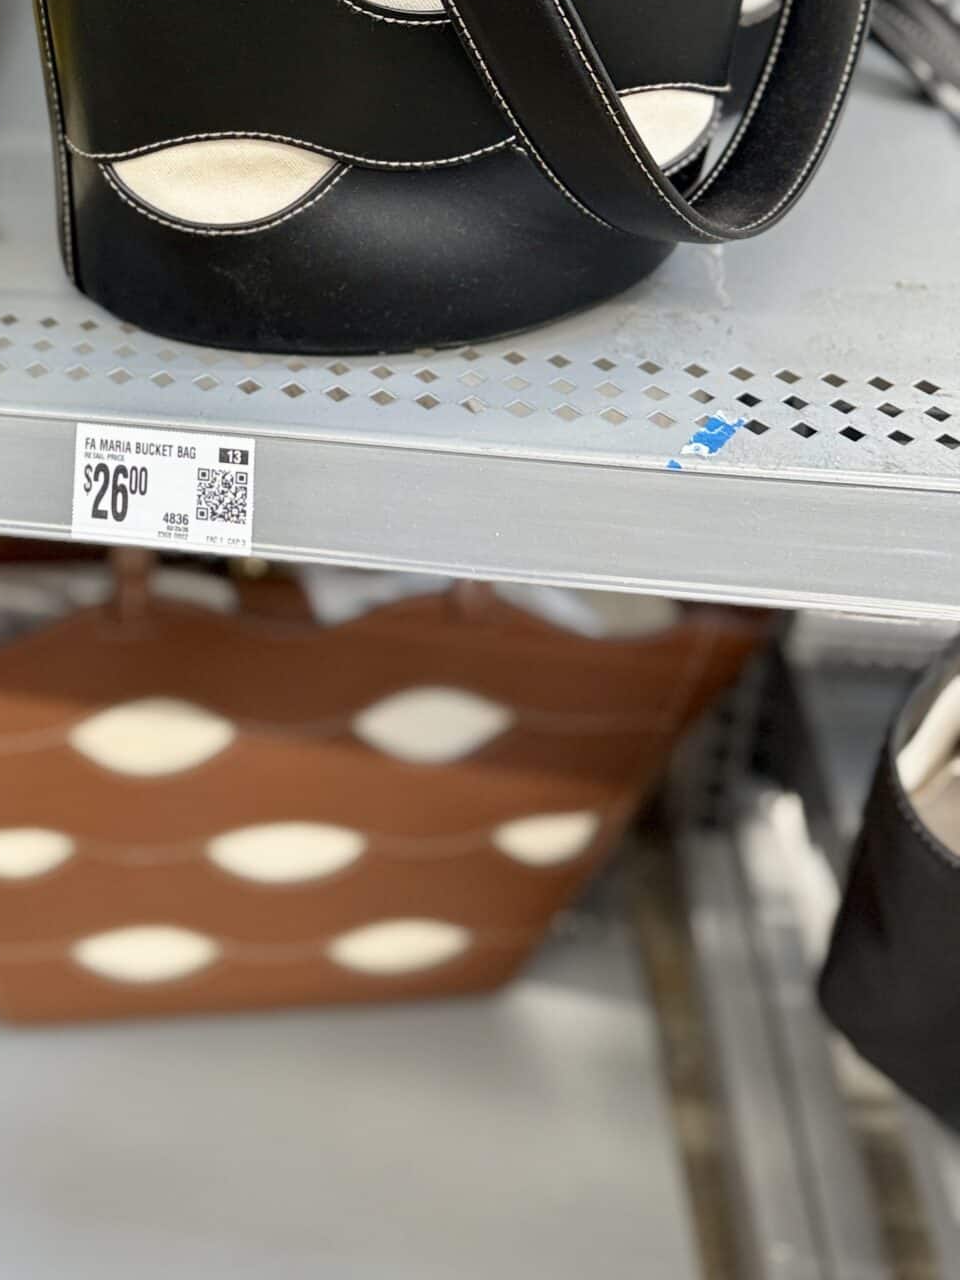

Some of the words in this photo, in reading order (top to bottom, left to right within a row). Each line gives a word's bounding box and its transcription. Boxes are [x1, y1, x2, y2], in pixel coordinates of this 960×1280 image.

[85, 437, 96, 450] FA
[100, 438, 131, 454] MARIA
[135, 442, 173, 458] BUCKET
[177, 445, 196, 460] BAG
[226, 450, 242, 464] 13
[163, 512, 189, 526] 4836
